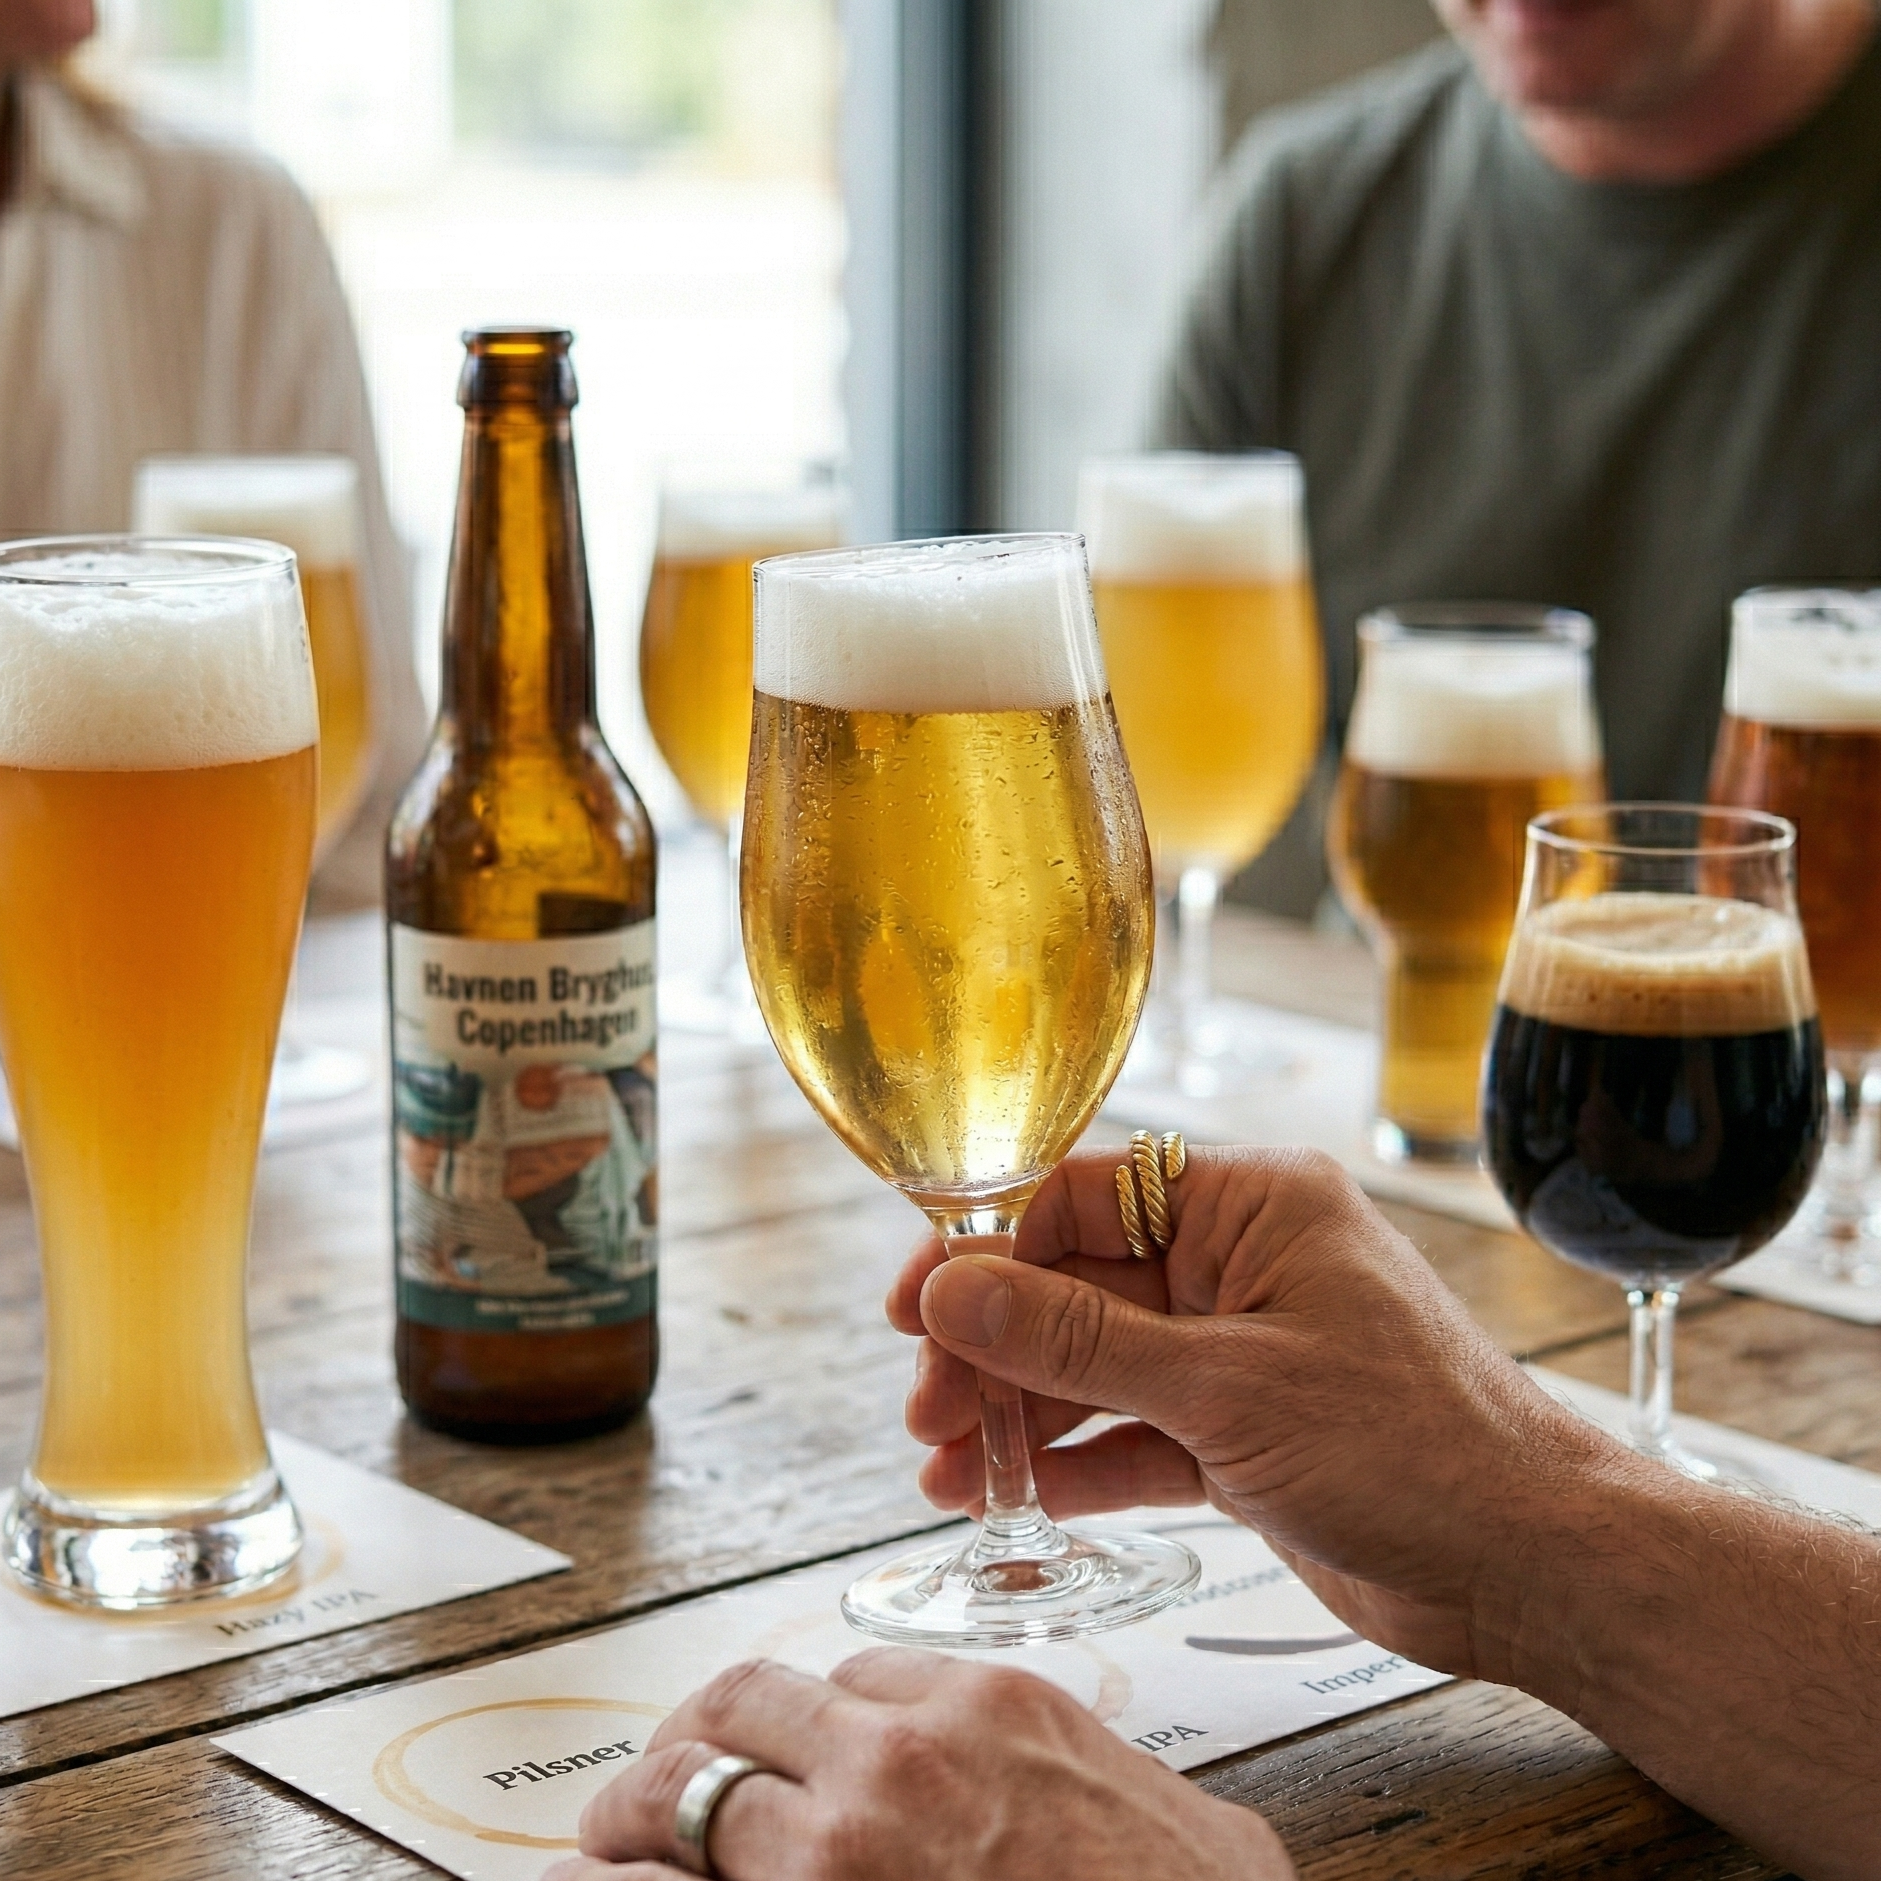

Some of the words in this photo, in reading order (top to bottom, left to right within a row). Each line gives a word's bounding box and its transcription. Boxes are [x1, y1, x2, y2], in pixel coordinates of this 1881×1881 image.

[424, 962, 537, 1003] Havnen
[457, 1007, 636, 1054] Copenhagen
[311, 1589, 377, 1612] IPA
[1299, 1655, 1405, 1695] Imper
[1130, 1725, 1210, 1753] IPA
[482, 1740, 640, 1791] Pilsner
